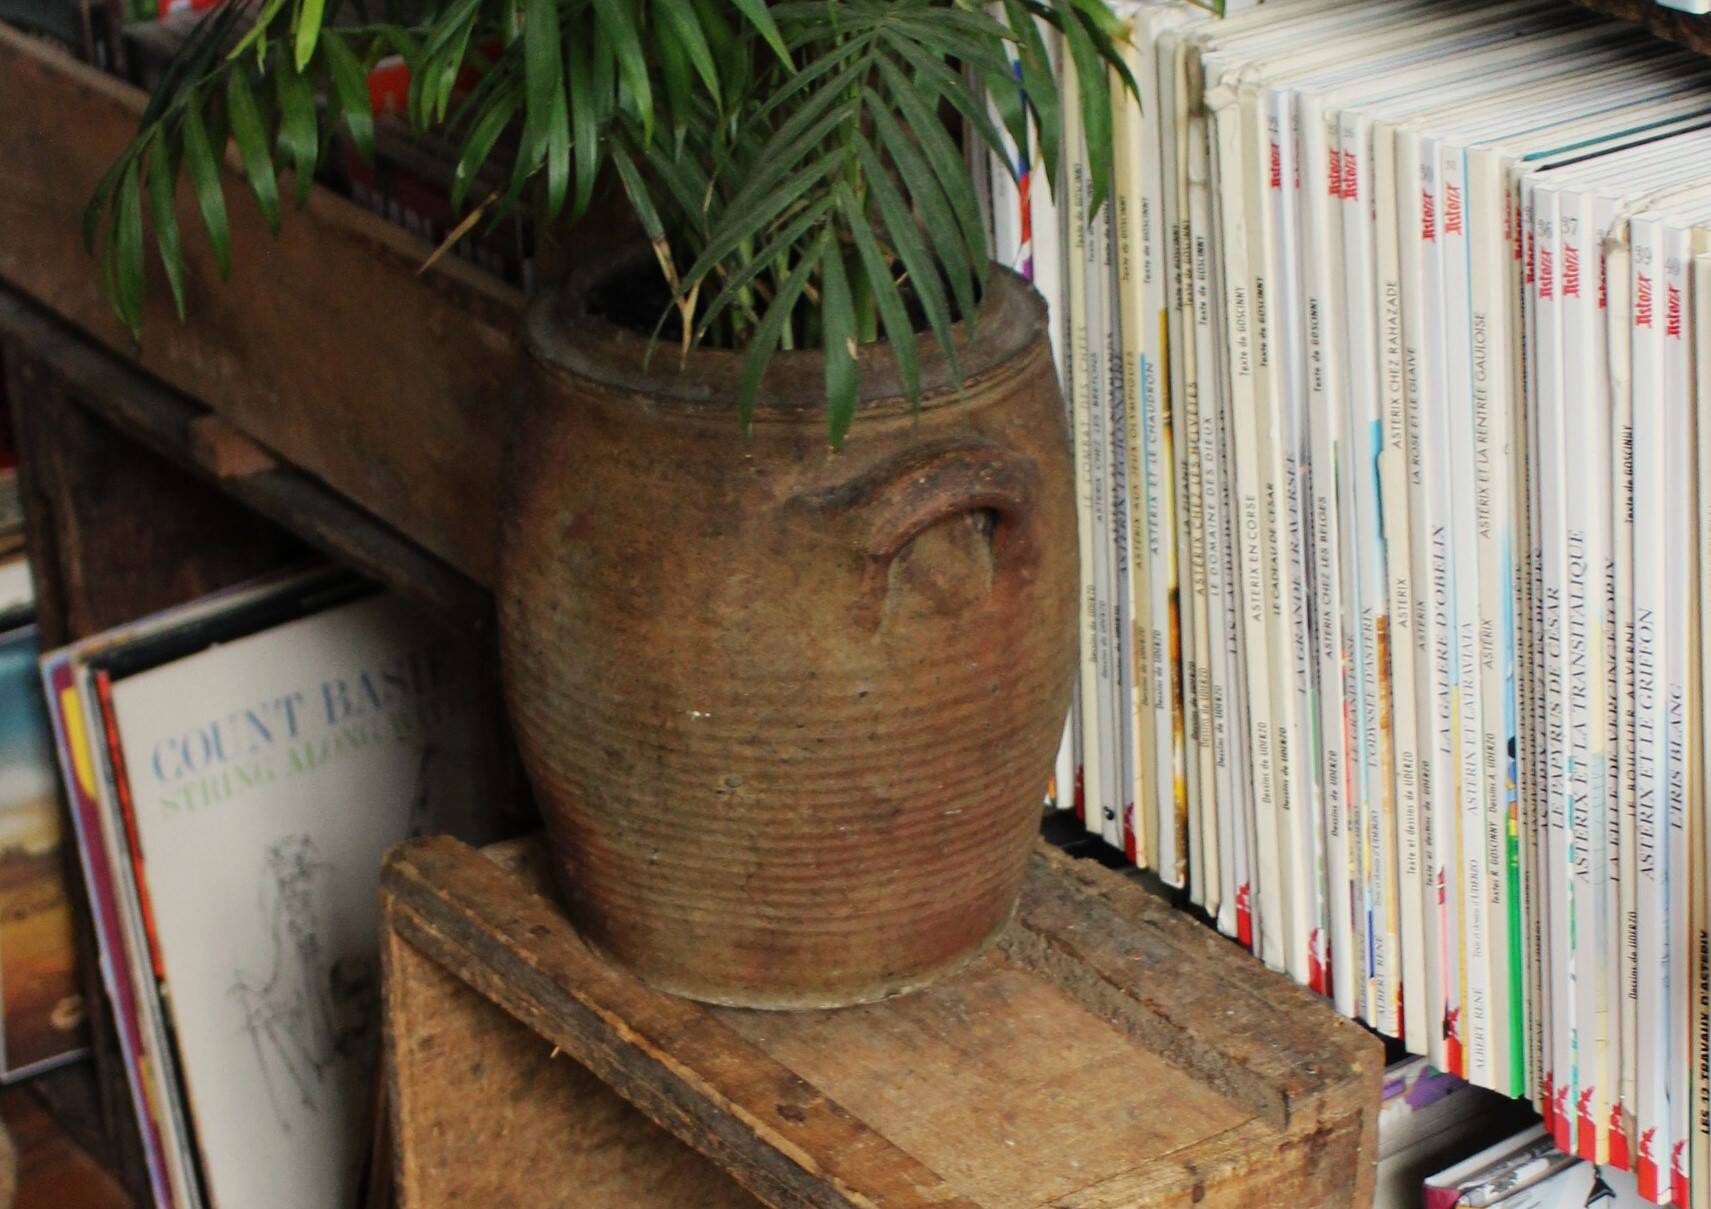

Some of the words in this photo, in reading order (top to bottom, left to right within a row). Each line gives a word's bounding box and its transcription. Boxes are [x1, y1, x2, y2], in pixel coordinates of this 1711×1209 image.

[1235, 287, 1247, 332] GOSCINNY
[1386, 280, 1399, 353] RAHAZADE
[1238, 336, 1248, 347] de
[1473, 312, 1487, 379] GAULOISE
[1239, 352, 1250, 376] Texte
[1388, 358, 1400, 392] CHEZ
[1406, 348, 1417, 392] GLAIVE
[1408, 395, 1418, 409] LE
[1475, 389, 1488, 443] RENTRÉE
[1408, 412, 1418, 428] ET
[1203, 417, 1215, 461] DIEUX
[1409, 434, 1420, 466] ROSE
[1476, 448, 1489, 464] LA
[1205, 468, 1216, 496] DES
[1411, 470, 1420, 484] LA
[1477, 468, 1490, 482] ET
[1246, 496, 1258, 540] CORSE
[1318, 496, 1328, 541] BELGES
[1206, 508, 1218, 572] DOMAINE
[1269, 526, 1278, 543] DE
[1249, 546, 1259, 561] EN
[1320, 546, 1329, 568] LES
[1270, 546, 1280, 599] CADEAU
[1209, 582, 1219, 596] LE
[1321, 574, 1330, 605] CHEZ
[1272, 602, 1281, 615] LE
[1568, 530, 1585, 713] TRANSITALIQUE
[1638, 608, 1653, 709] GRIFFON
[1548, 670, 1561, 693] DE
[152, 691, 304, 783] COUNT
[1464, 728, 1476, 745] ET
[1571, 721, 1586, 750] LA
[1639, 718, 1653, 744] LE
[1669, 684, 1682, 761] BLANC
[1438, 727, 1450, 754] LA
[1487, 734, 1497, 768] UDERZO
[1549, 702, 1564, 795] PAPYRUS
[159, 765, 276, 813] STRING
[287, 728, 371, 779] ALONG
[1328, 751, 1337, 785] UDERZO
[1403, 752, 1414, 786] UDERZO
[1571, 758, 1586, 784] ET
[1639, 756, 1653, 779] ET
[1330, 790, 1338, 801] de
[1404, 789, 1414, 799] de
[1488, 784, 1498, 812] Dessins
[1670, 770, 1682, 830] L'IRIS
[1330, 805, 1339, 836] Dessins
[1405, 803, 1415, 834] dessins
[1552, 804, 1565, 830] LE
[1406, 838, 1415, 847] et
[1489, 821, 1499, 864] GOSCINNY
[1406, 852, 1416, 874] Texte
